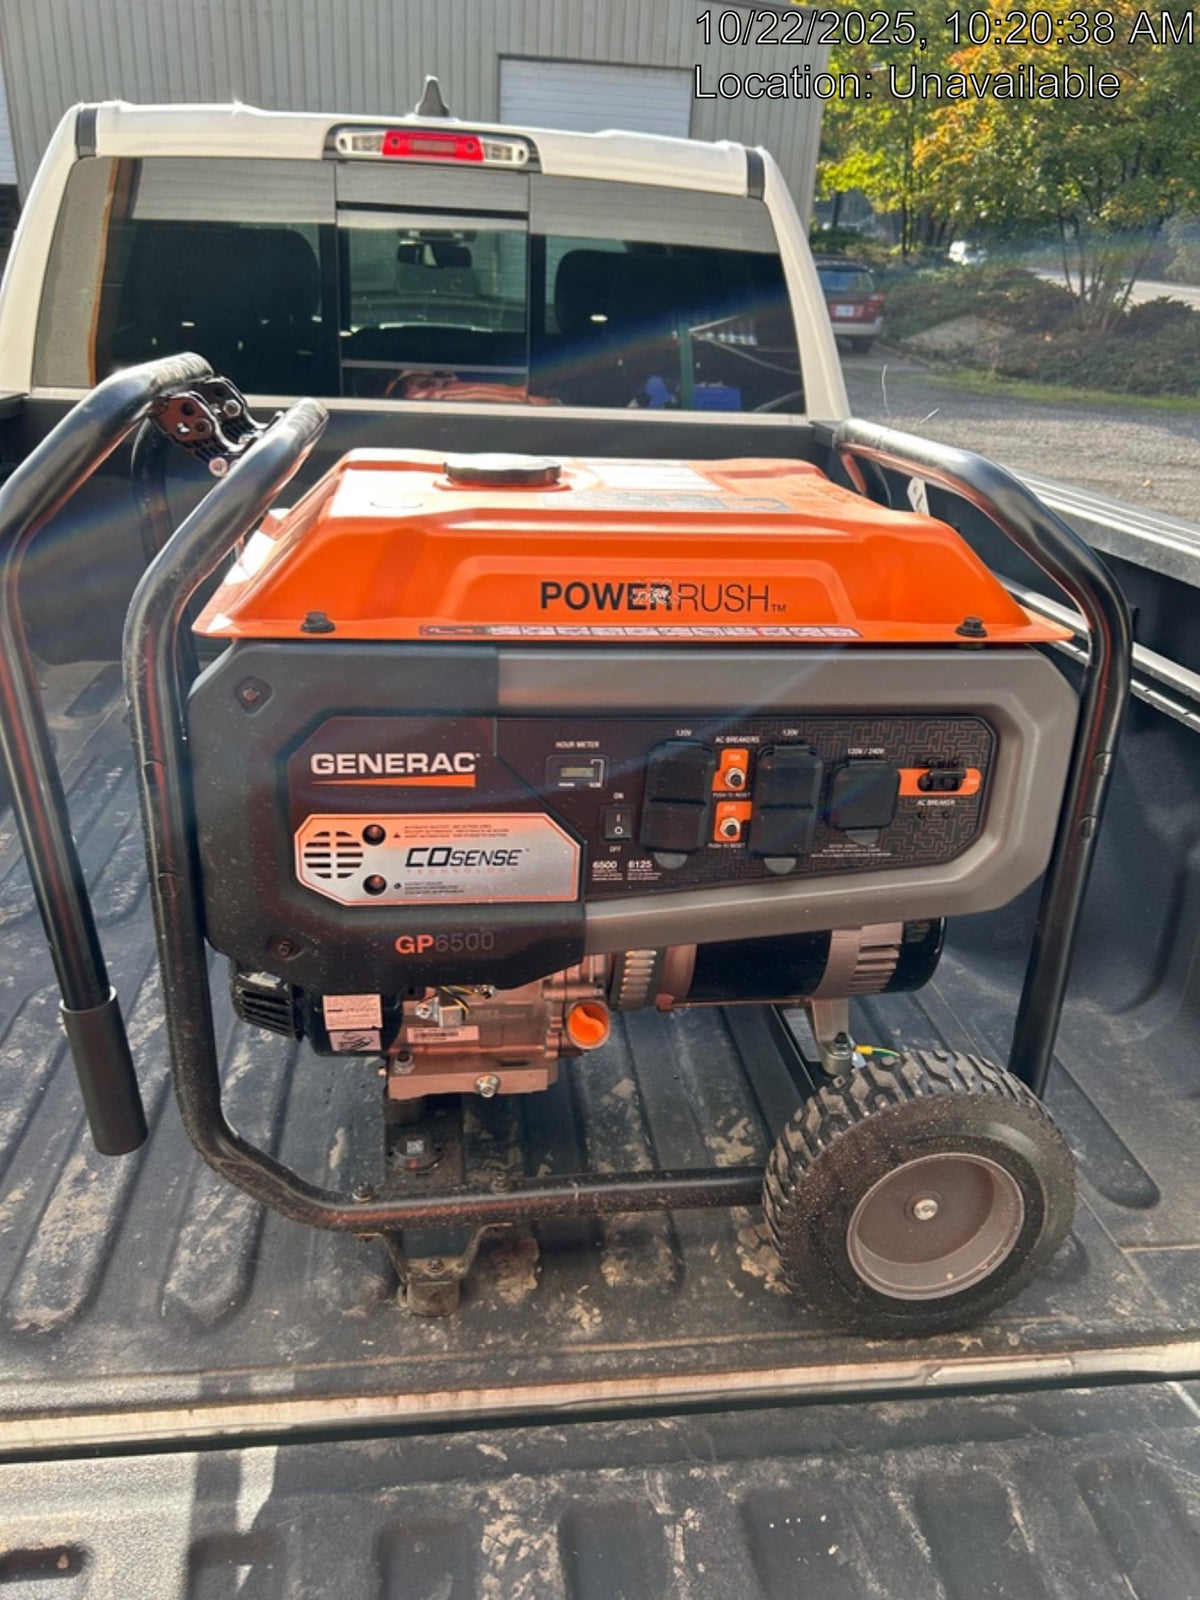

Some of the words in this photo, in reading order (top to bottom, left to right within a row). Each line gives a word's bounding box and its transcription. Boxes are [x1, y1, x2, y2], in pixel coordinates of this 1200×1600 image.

[675, 729, 693, 737] 120V
[782, 729, 800, 737] 120V
[714, 736, 725, 744] AC
[727, 736, 760, 744] BREAKERS
[577, 741, 600, 749] METER
[310, 752, 477, 775] GENERAC
[613, 792, 625, 800] ON
[609, 845, 622, 853] OFF
[627, 859, 653, 869] 8125
[394, 931, 495, 955] GP6500
